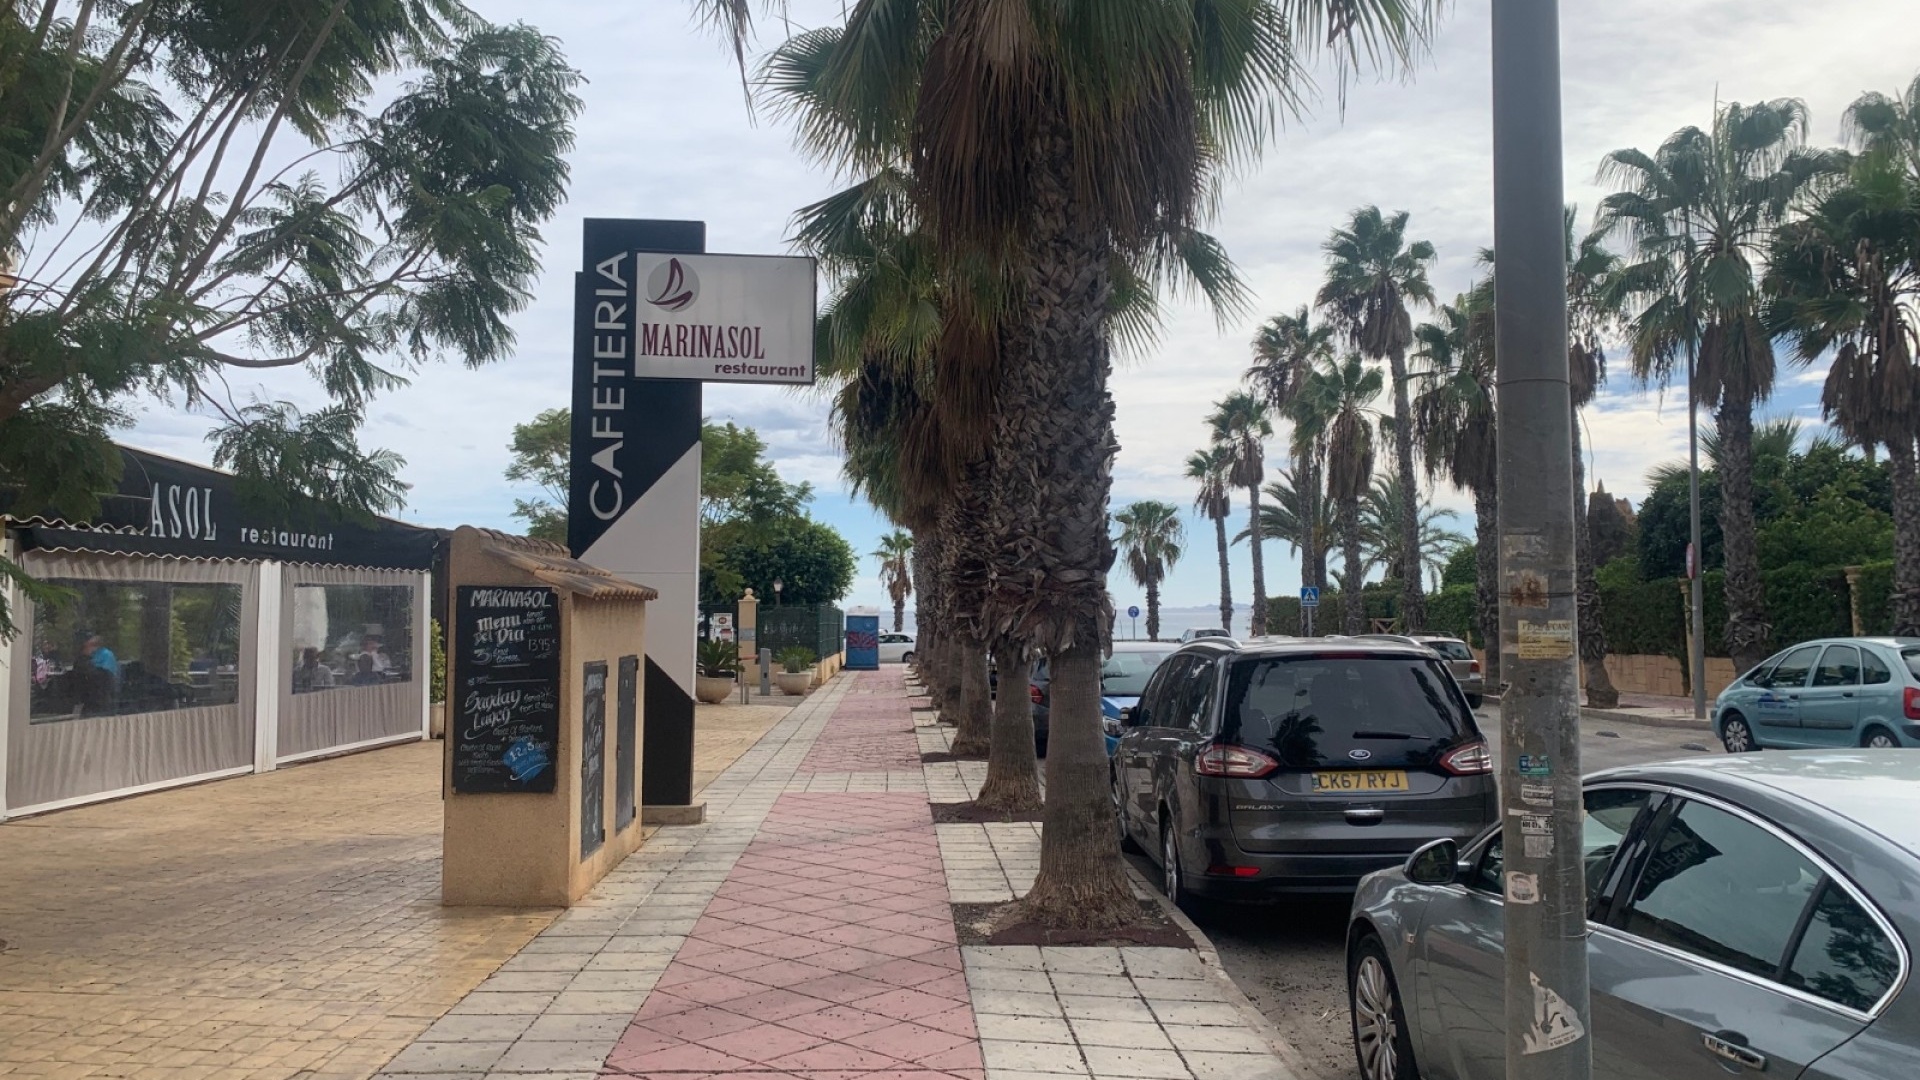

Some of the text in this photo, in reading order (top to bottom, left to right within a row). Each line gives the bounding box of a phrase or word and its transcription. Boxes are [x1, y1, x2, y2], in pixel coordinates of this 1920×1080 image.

[640, 323, 765, 360] MARINASOL
[714, 363, 806, 377] restaurant
[589, 251, 628, 520] CAFETERIA
[470, 589, 552, 609] MARINASOL
[476, 615, 521, 630] Menu
[1319, 773, 1400, 789] CK67 RYJ
